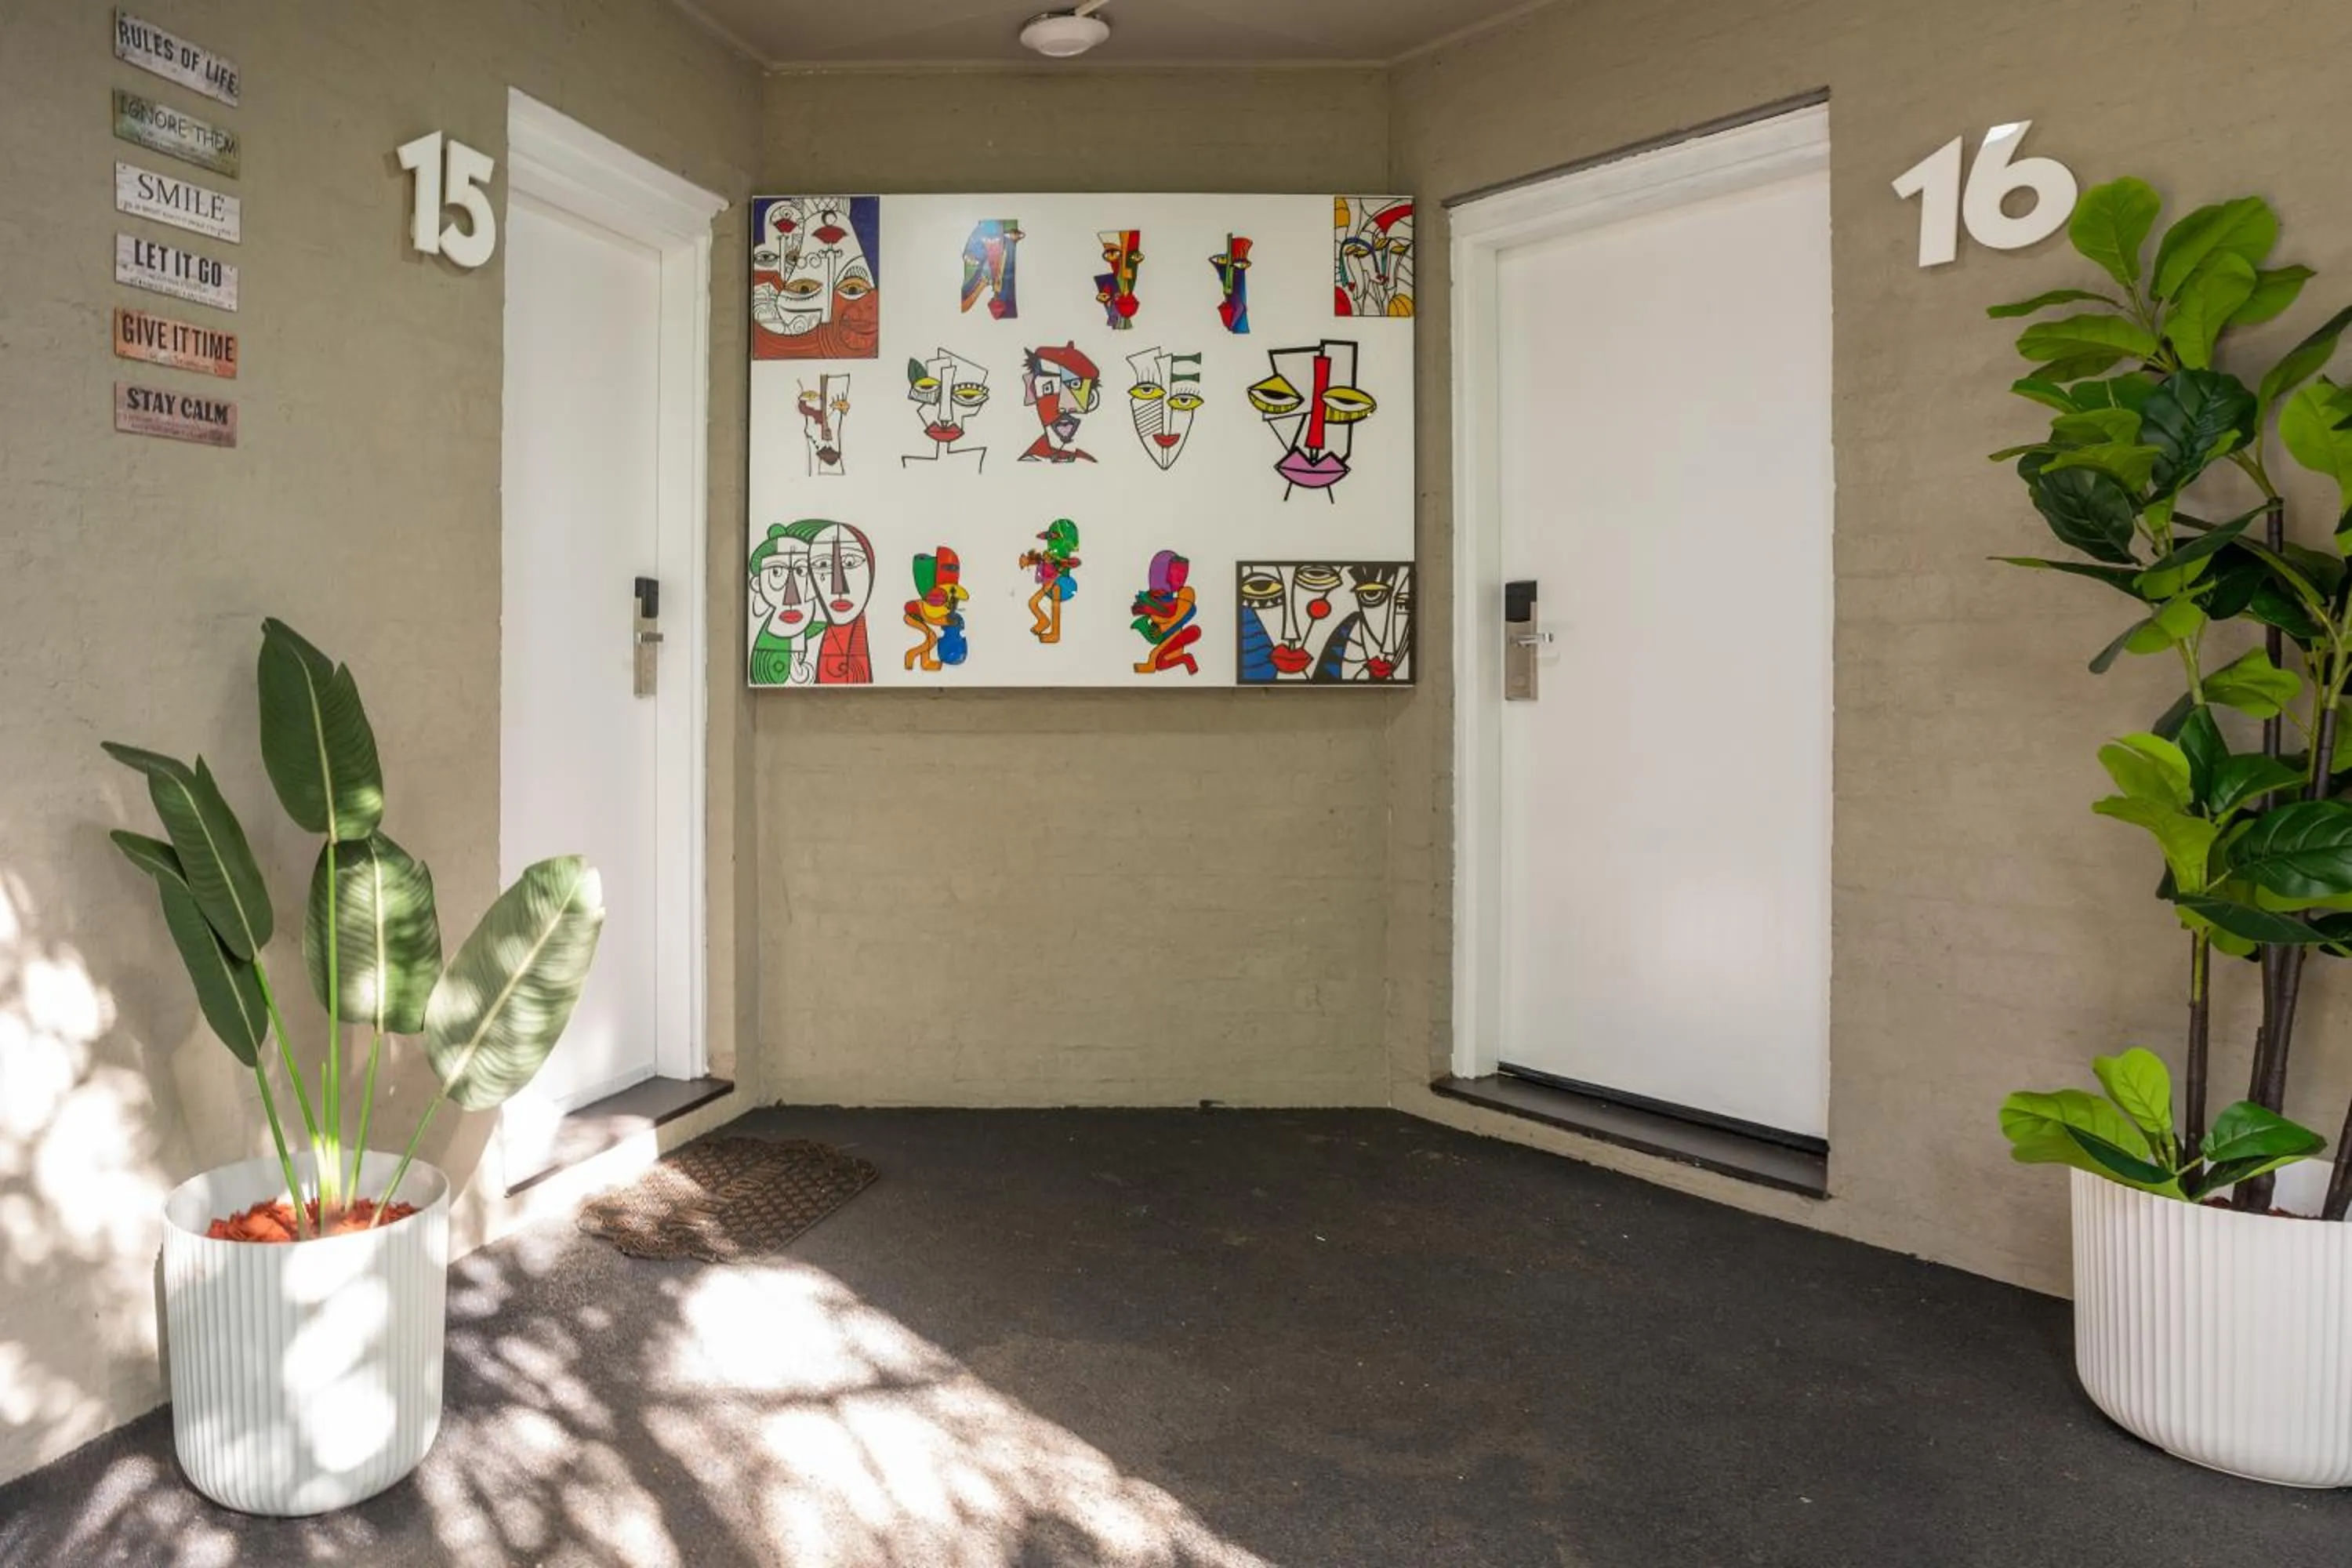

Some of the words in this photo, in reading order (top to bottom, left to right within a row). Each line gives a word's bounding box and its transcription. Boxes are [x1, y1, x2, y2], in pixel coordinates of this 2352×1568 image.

[118, 20, 173, 61] RULES
[181, 47, 199, 71] OF
[206, 60, 238, 94] LIFE
[121, 95, 187, 138] IGNORE
[138, 172, 225, 222] SMILE
[397, 129, 496, 267] 15
[1891, 120, 2078, 267] 16
[135, 238, 168, 272] LET
[176, 250, 191, 278] IT
[199, 258, 222, 287] GO
[123, 314, 167, 350] GIVE
[173, 325, 189, 353] IT
[191, 329, 234, 361] TIME
[127, 387, 176, 415] STAY
[180, 397, 228, 425] CALM
